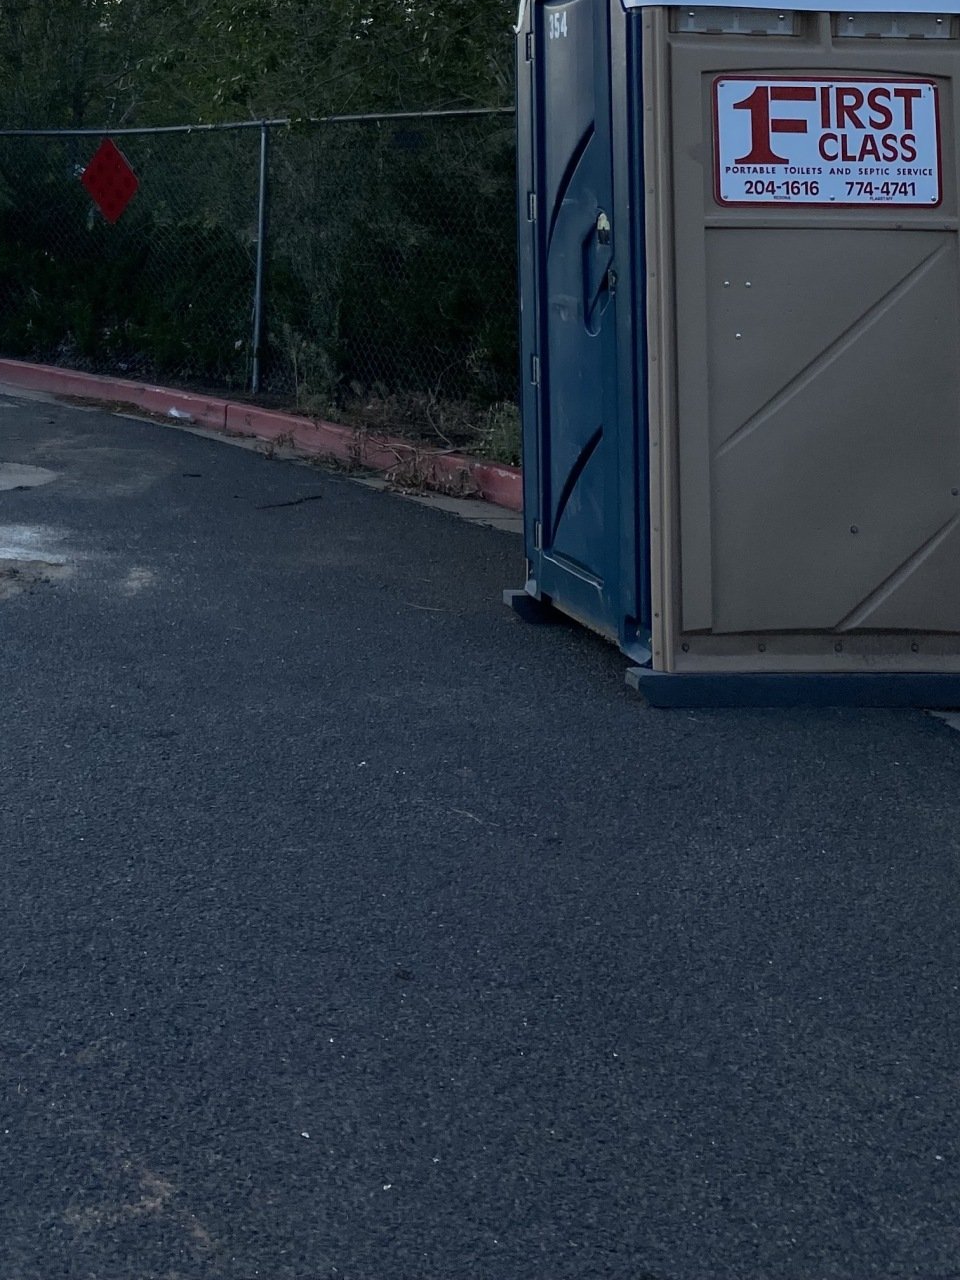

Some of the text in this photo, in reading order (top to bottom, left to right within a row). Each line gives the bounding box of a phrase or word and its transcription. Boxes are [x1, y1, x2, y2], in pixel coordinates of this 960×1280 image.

[549, 11, 568, 39] 354
[818, 132, 917, 163] CLASS
[725, 166, 776, 175] PORTABLE
[784, 167, 823, 175] TOILETS
[858, 168, 890, 176] SEPTIC
[897, 168, 933, 176] SERVICE
[744, 180, 916, 197] 204-1616 774-4741
